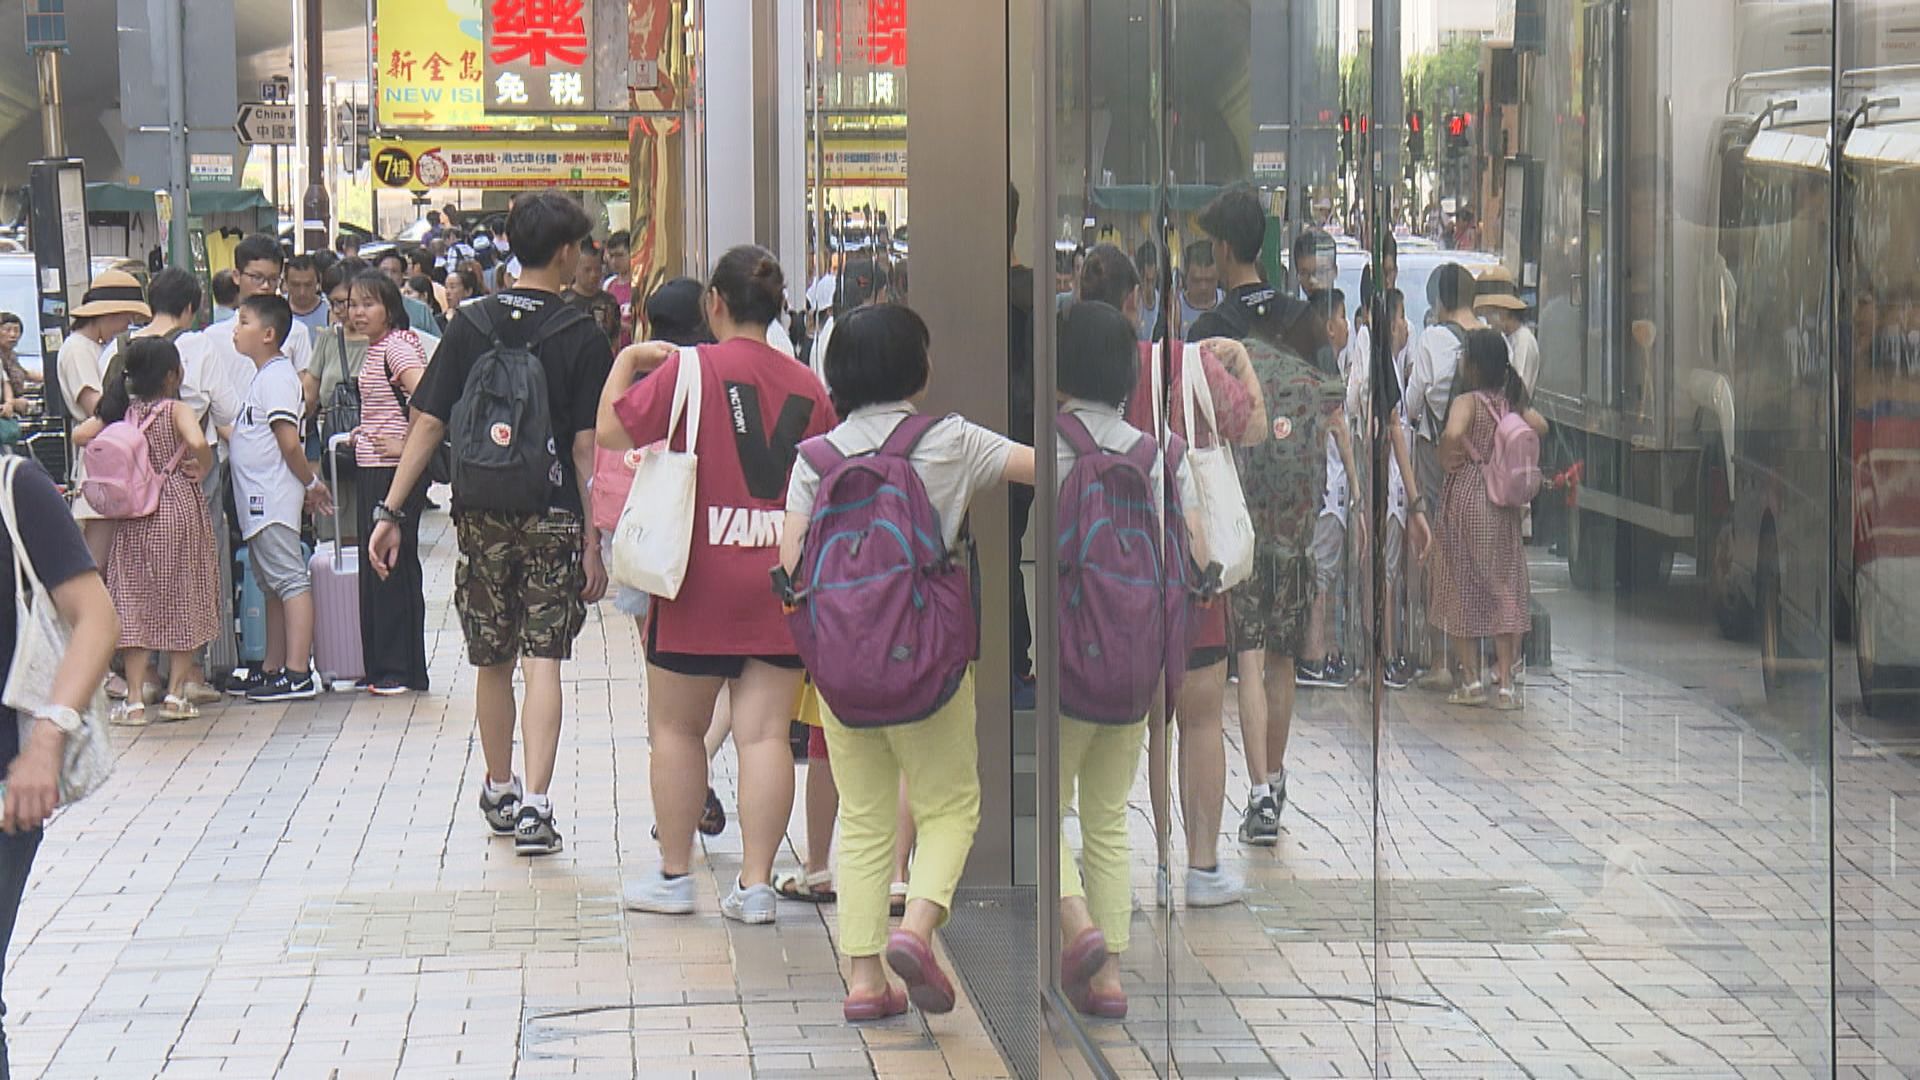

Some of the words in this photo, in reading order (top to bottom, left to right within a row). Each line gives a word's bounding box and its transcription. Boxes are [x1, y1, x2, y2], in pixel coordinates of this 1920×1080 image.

[386, 87, 443, 103] NEW
[255, 109, 287, 119] China
[727, 385, 748, 434] VICTORY
